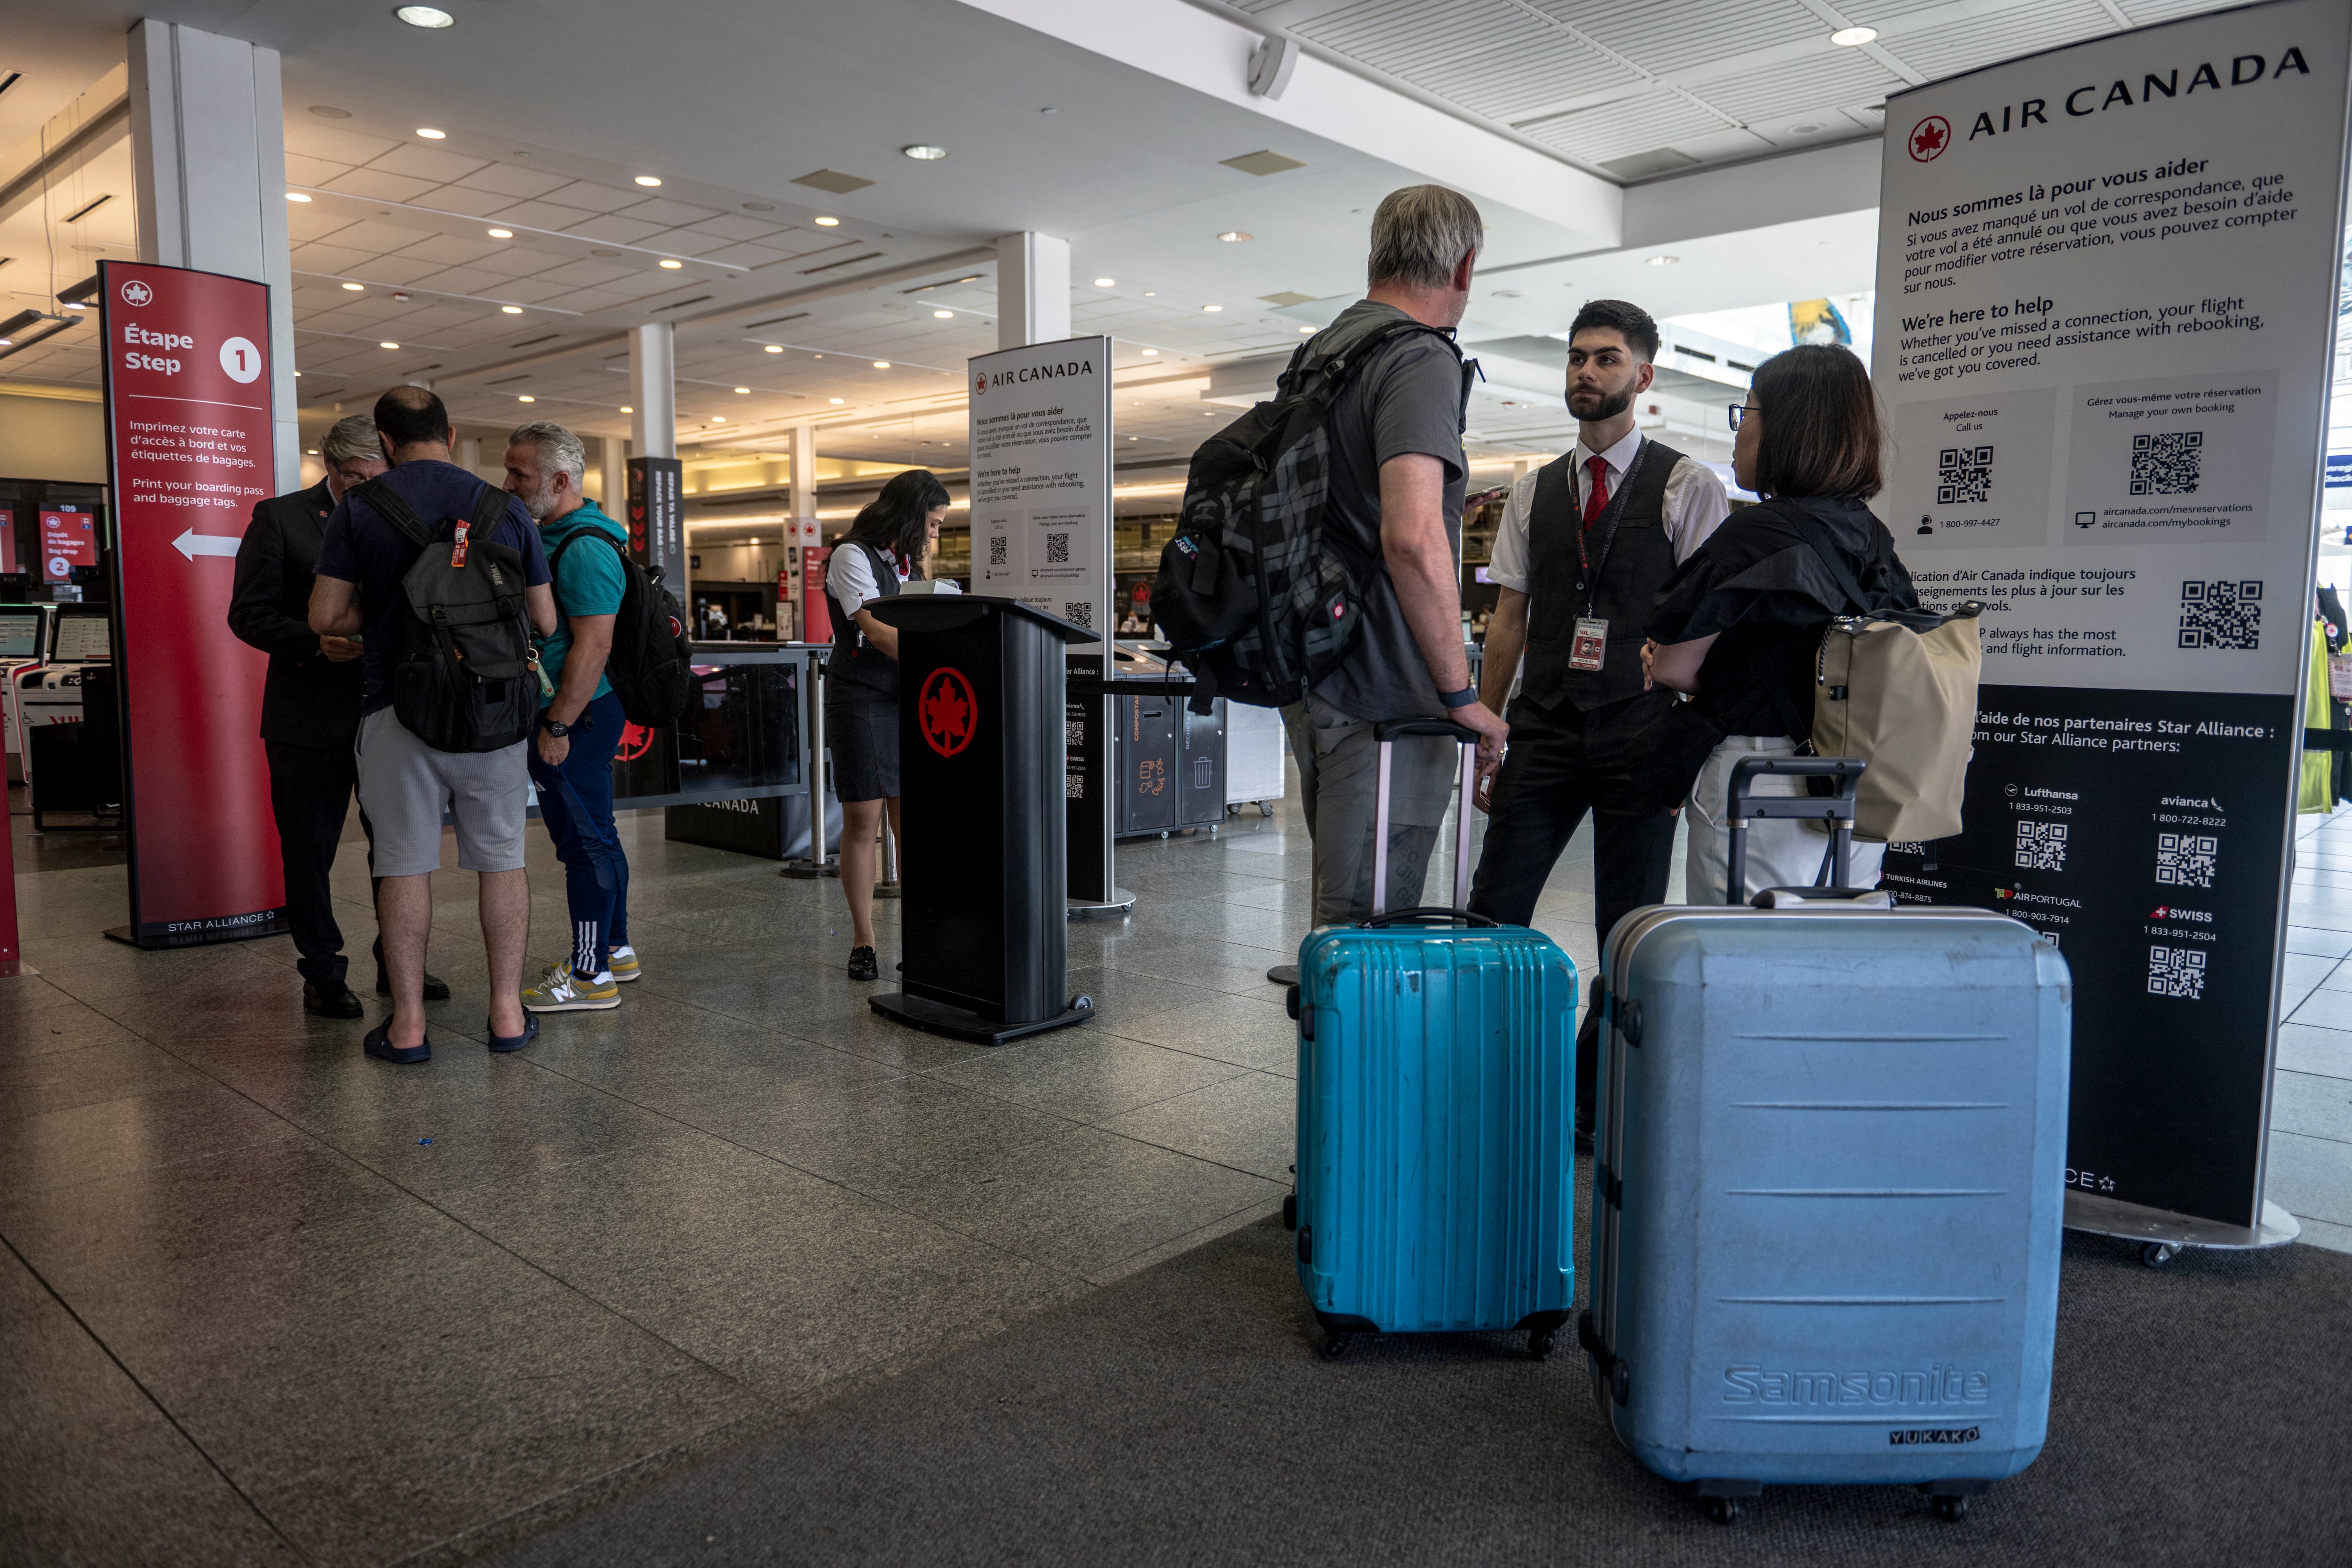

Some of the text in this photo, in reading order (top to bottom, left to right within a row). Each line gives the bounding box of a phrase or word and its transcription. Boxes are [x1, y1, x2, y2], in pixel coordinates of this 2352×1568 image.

[1969, 47, 2311, 141] AIR CANADA
[1908, 159, 2209, 226] Nous sommes là pour vous aider
[1907, 174, 2283, 247] Si vous avez manqué un vol de correspondance, que
[1904, 276, 1955, 294] sur nous.
[1902, 296, 2053, 332] We're here to help
[1901, 297, 2244, 350] Whether you've missed a connection, your flight
[125, 323, 193, 350] Étape
[126, 352, 181, 375] Step
[235, 350, 246, 372] 1
[1899, 352, 2040, 382] we've got you covered.
[992, 361, 1092, 387] AIR CANADA
[2087, 397, 2114, 406] Gérez
[2116, 393, 2171, 404] vous-même
[2204, 387, 2261, 398] réservation
[1017, 412, 1030, 422] pour
[1943, 408, 1998, 422] Appelez-nous
[2109, 410, 2144, 419] Manage
[2146, 408, 2169, 418] your
[2195, 403, 2234, 413] booking
[130, 421, 246, 439] Imprimez votre carte
[1956, 423, 1971, 432] Call
[131, 435, 175, 446] d'accès
[179, 437, 185, 447] à
[189, 438, 214, 450] bord
[217, 442, 228, 451] et
[131, 450, 256, 468] étiquettes de bagages.
[977, 469, 989, 478] We're
[990, 468, 1001, 477] here
[1009, 466, 1020, 475] help
[133, 478, 264, 496] Print your boarding pass
[134, 493, 238, 509] and baggage tags.
[2103, 504, 2253, 516] aircanada.com/mesreservations
[1946, 518, 2000, 528] 800-997-4427
[2102, 517, 2231, 528] aircanada.com/mybookings
[56, 562, 64, 571] 2
[490, 562, 503, 585] THULE
[1986, 643, 2126, 657] and flight information.
[2013, 713, 2030, 725] de
[2034, 716, 2059, 727] nos
[2065, 718, 2152, 732] partenaires
[2157, 720, 2191, 734] Star
[2196, 722, 2264, 737] Alliance
[2025, 788, 2078, 800] Lufthansa
[2161, 796, 2208, 808] avianca
[2016, 803, 2072, 814] 833-951-2503
[2160, 814, 2226, 827] 800-722-8222
[1886, 874, 1947, 888] TURKISH AIRLINES
[168, 914, 264, 931] STAR ALLIANCE
[2012, 910, 2069, 924] 800-903-7914
[2169, 908, 2212, 922] SWISS
[2152, 926, 2216, 941] 833-951-2504
[1723, 1364, 1988, 1405] Samsonite
[1892, 1428, 1978, 1443] YUKAKO
